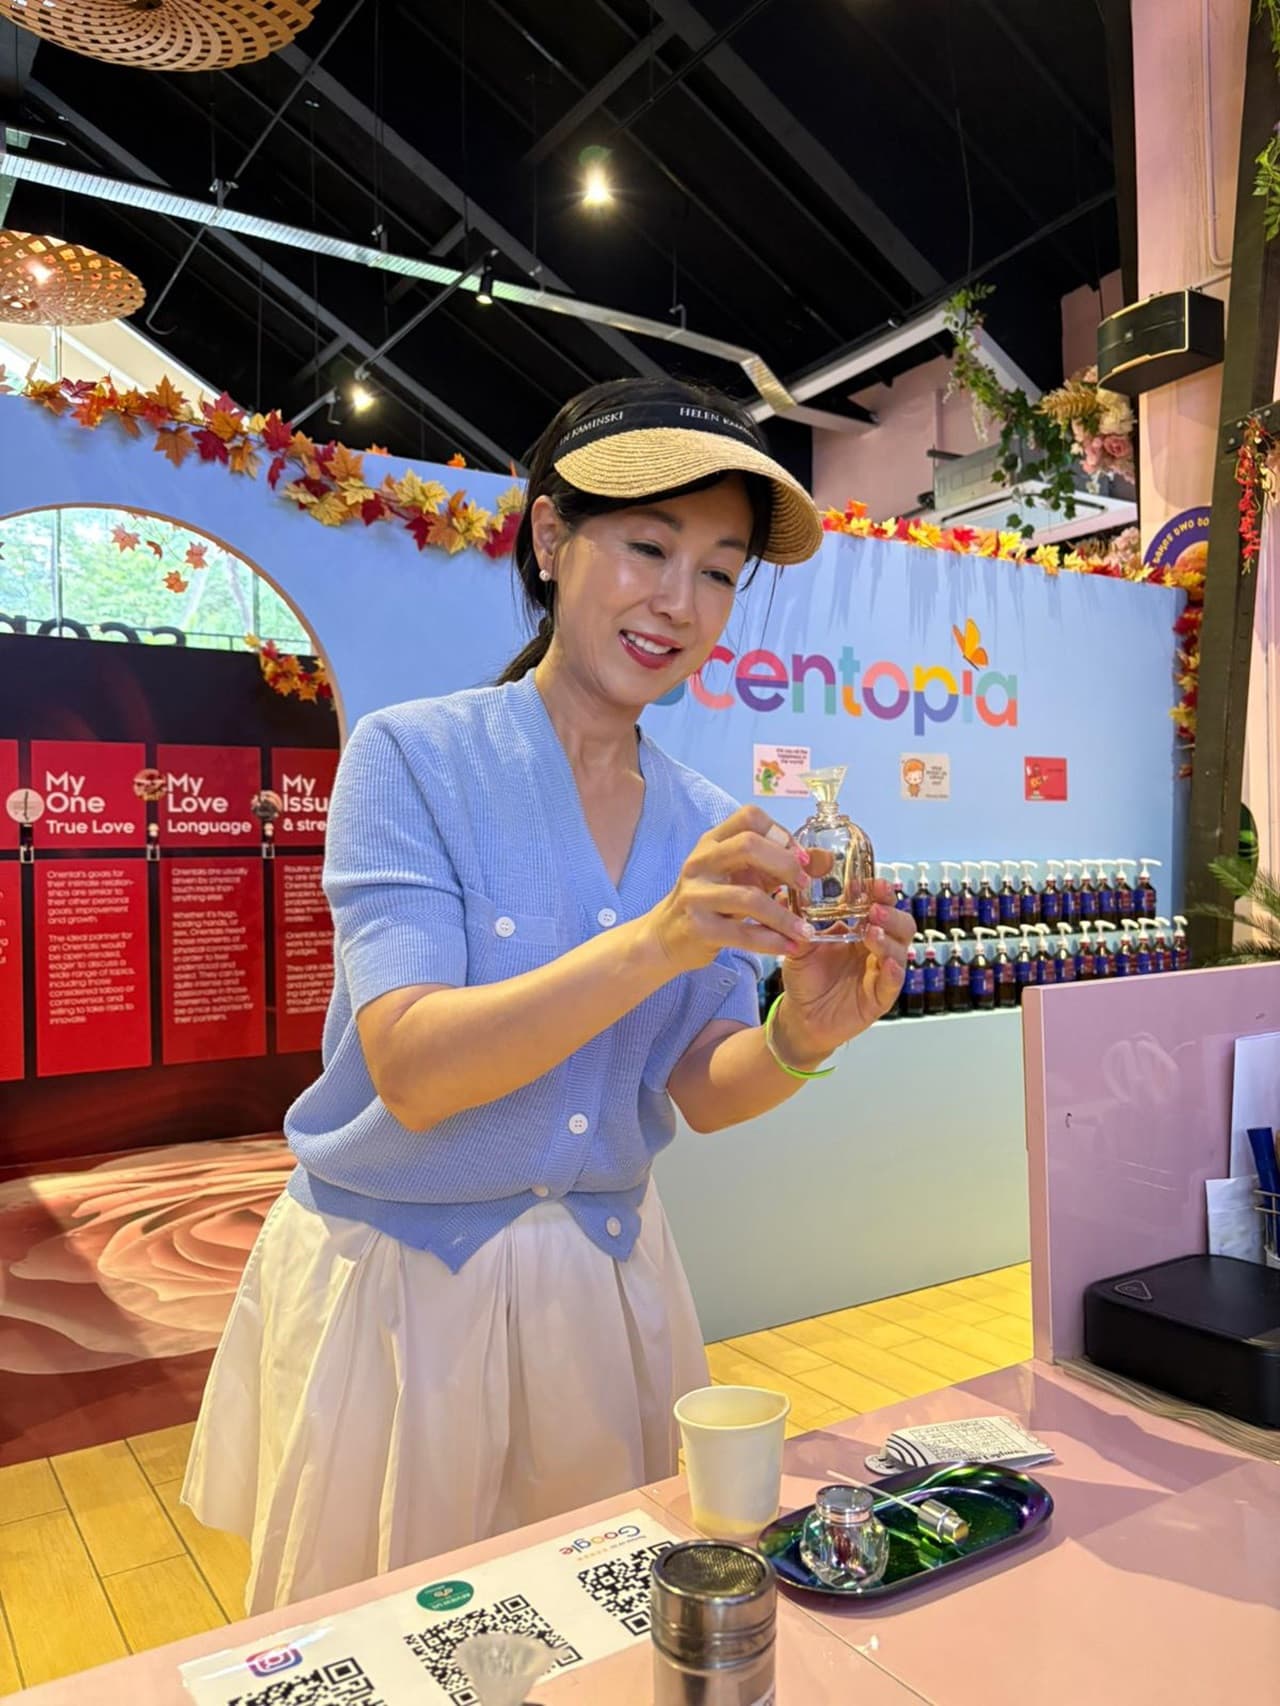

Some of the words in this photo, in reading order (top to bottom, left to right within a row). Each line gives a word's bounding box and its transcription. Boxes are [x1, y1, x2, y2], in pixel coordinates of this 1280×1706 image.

[571, 411, 624, 438] KAMINSKI
[680, 408, 719, 422] HELEN
[652, 645, 1018, 737] centopia
[46, 772, 85, 796] My
[168, 772, 204, 796] My
[282, 774, 316, 796] My
[46, 792, 106, 814] One
[168, 794, 228, 813] Love
[282, 795, 328, 812] Issu
[46, 820, 88, 834] True
[92, 820, 135, 834] Love
[168, 818, 252, 836] Language
[282, 820, 293, 832] &
[293, 819, 327, 832] stre
[560, 1525, 641, 1555] Google
